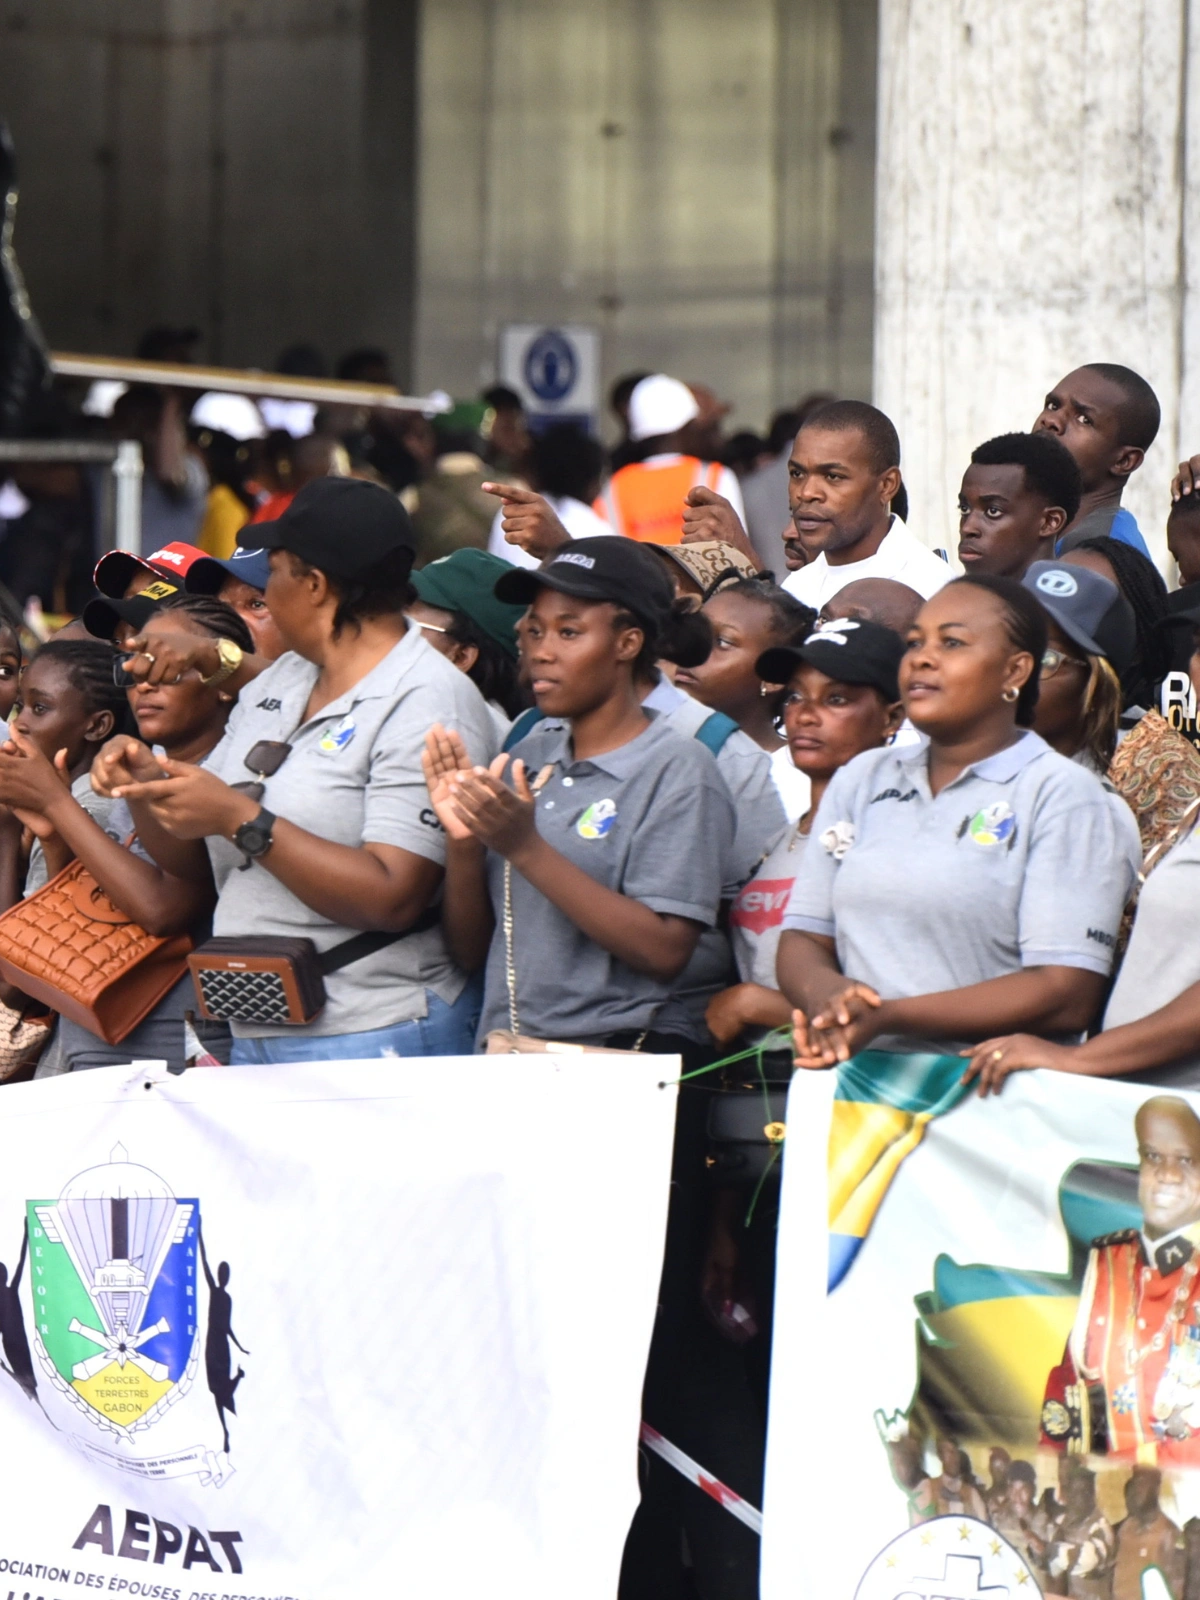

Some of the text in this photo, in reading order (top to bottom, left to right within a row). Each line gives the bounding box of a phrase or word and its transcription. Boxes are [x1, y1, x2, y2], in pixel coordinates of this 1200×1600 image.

[33, 1227, 49, 1335] DEVOIR
[186, 1226, 194, 1336] PATRIE
[94, 1389, 149, 1398] TERRESTRES
[103, 1376, 140, 1385] FORCES
[103, 1403, 142, 1413] GABON
[71, 1503, 243, 1575] AEPAT
[73, 1571, 105, 1590] DES
[108, 1573, 181, 1600] ÉPOUSES
